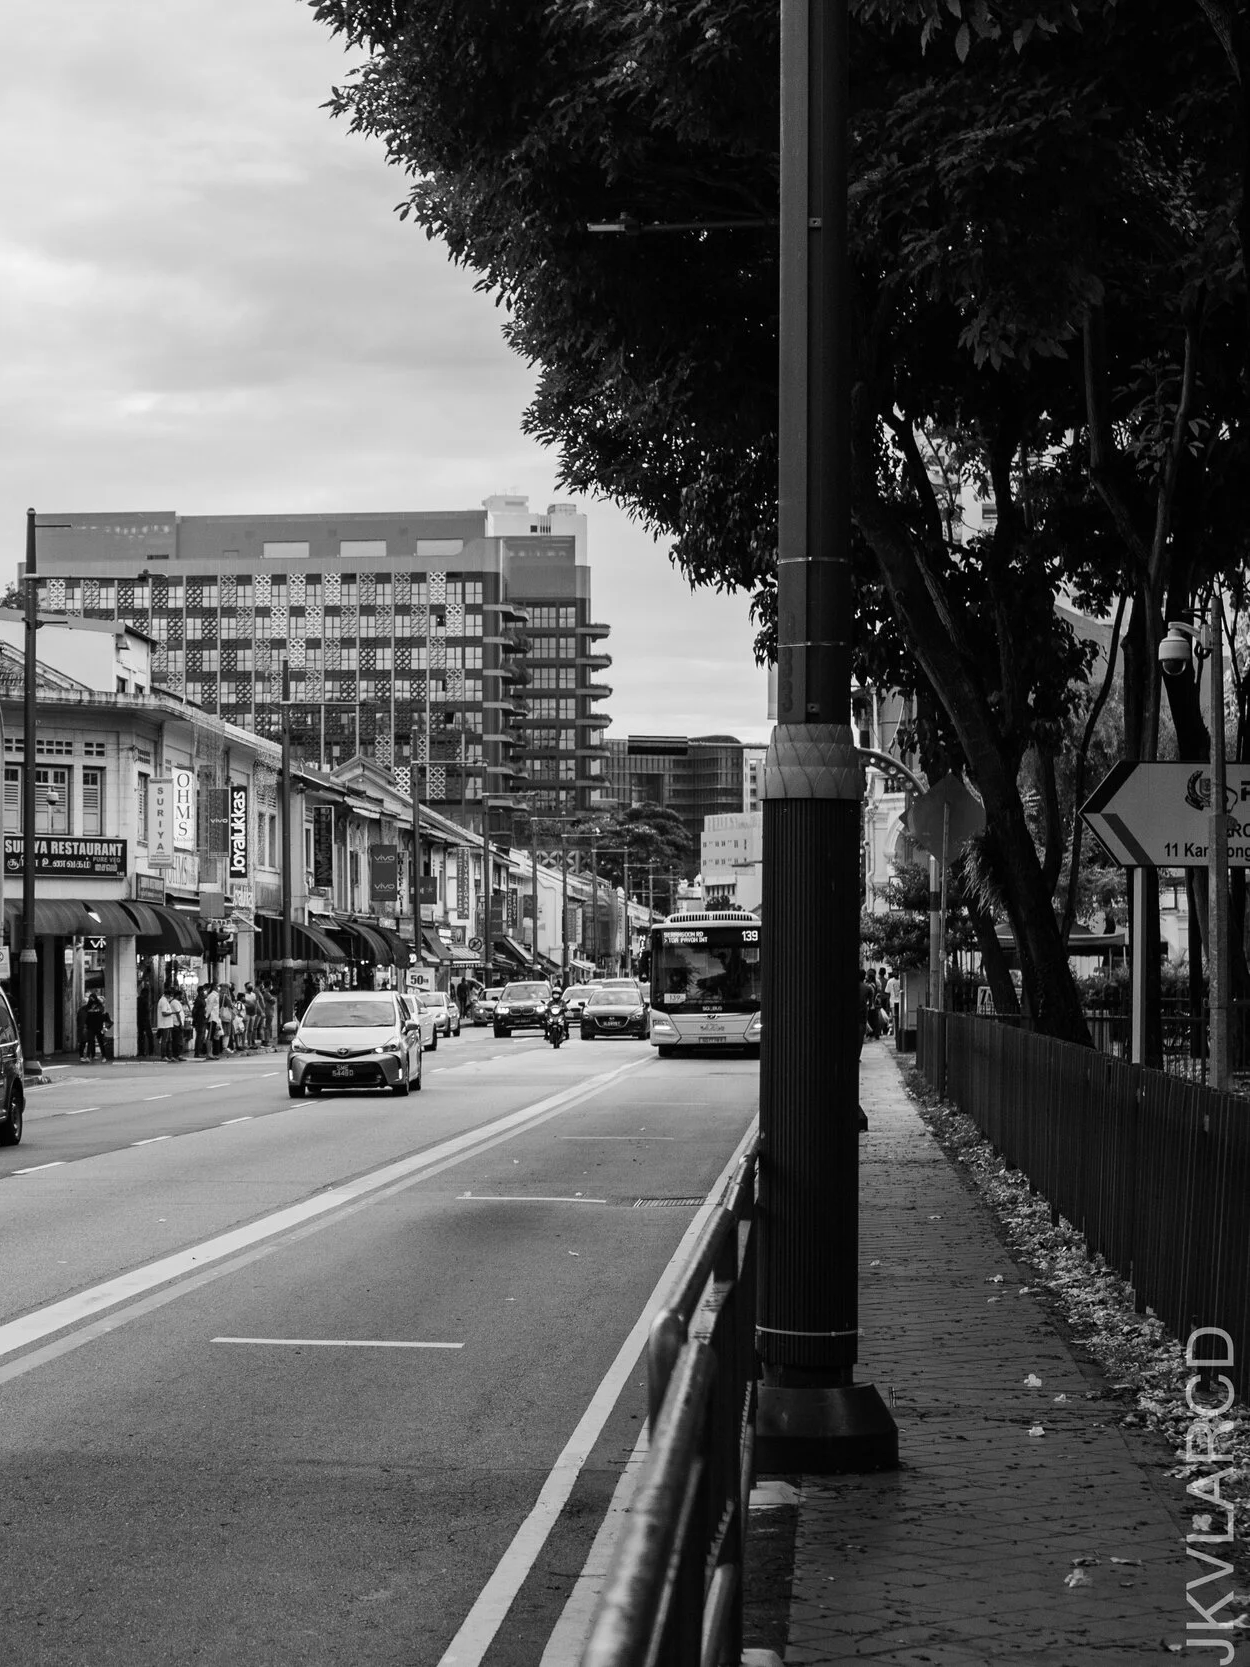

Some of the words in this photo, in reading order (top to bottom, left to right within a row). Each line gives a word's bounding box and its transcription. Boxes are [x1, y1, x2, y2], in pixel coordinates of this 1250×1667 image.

[176, 773, 190, 836] OHMS
[231, 791, 246, 874] Joyalukkas
[5, 840, 48, 855] SUYA
[51, 841, 123, 857] RESTAURANT
[1165, 843, 1178, 857] 11
[374, 882, 395, 890] vivo
[742, 930, 758, 941] 139
